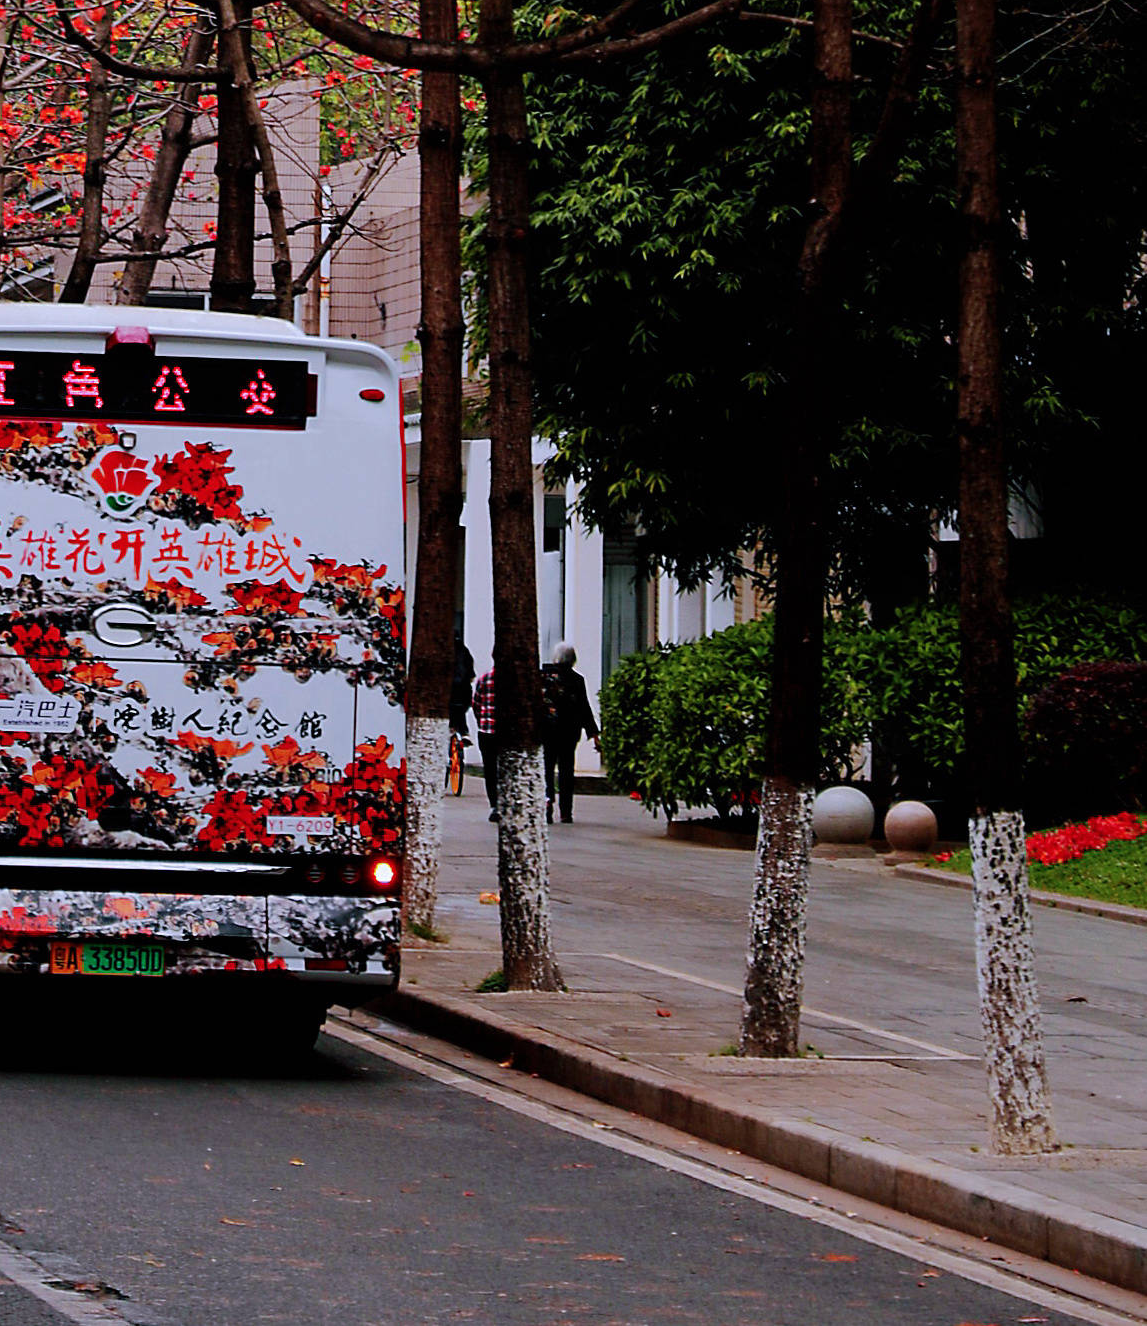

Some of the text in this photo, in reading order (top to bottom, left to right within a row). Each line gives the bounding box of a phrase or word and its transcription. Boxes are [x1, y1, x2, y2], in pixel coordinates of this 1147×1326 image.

[0, 700, 76, 719] 一汽巴士
[269, 819, 332, 833] Y1-6209
